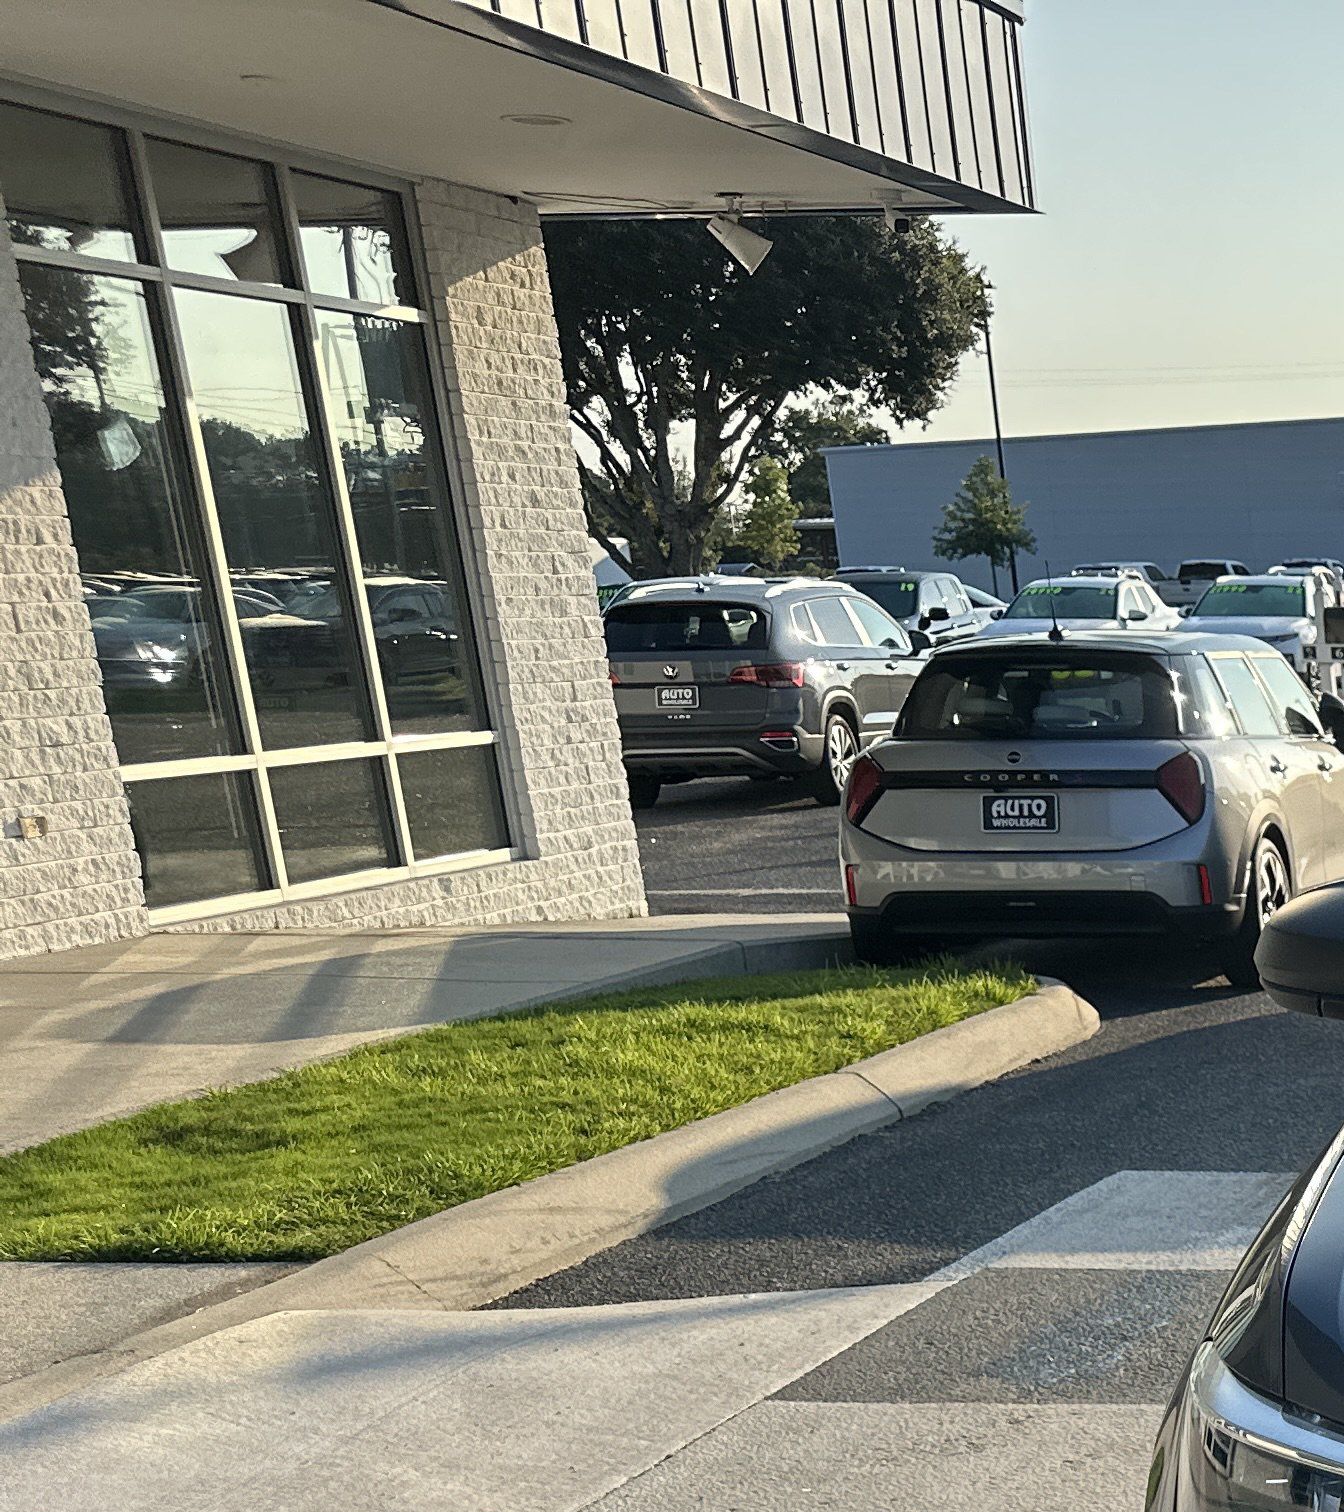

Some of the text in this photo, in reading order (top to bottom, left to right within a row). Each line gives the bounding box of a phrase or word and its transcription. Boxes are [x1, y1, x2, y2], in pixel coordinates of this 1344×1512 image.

[661, 688, 693, 700] AUTO
[963, 773, 1060, 782] COOPER
[991, 799, 1048, 818] AUTO
[991, 817, 1048, 828] WHOLESALE
